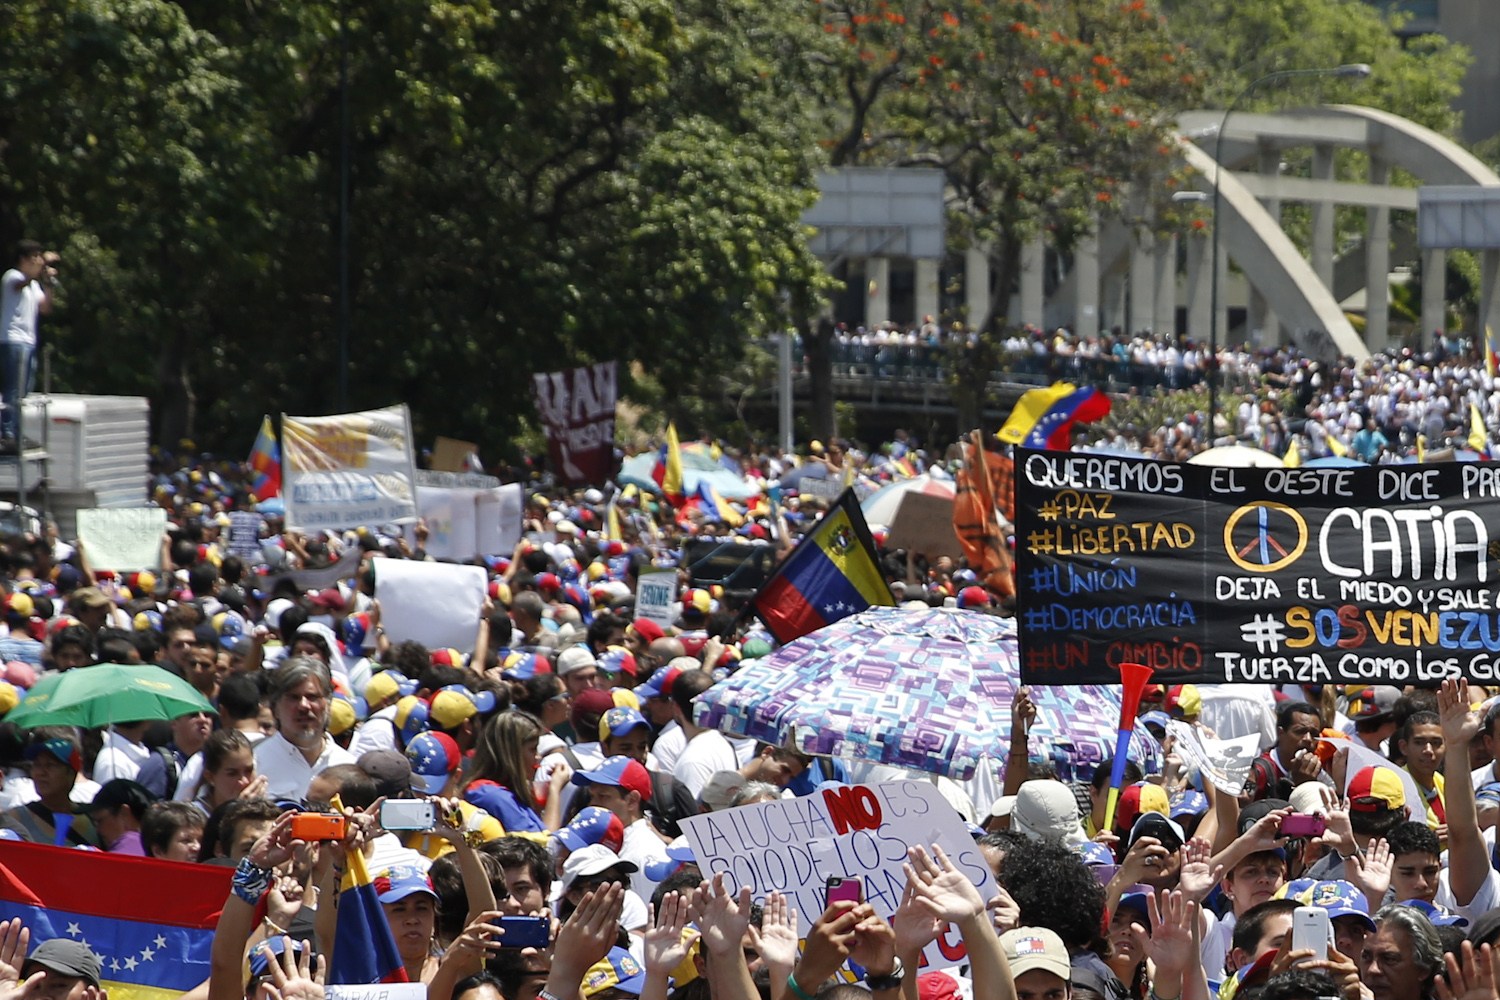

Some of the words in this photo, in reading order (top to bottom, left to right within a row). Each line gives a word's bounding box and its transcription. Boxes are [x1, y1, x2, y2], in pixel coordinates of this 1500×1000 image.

[1025, 454, 1184, 493] QUEREMOS
[1210, 467, 1246, 493] EL
[1264, 469, 1354, 496] OESTE
[1378, 470, 1440, 500] DICE
[1038, 489, 1116, 521] #PAZ
[1216, 575, 1281, 600] DEJA
[1297, 577, 1325, 599] EL
[1339, 580, 1412, 607] MIEDO
[1417, 589, 1434, 613] Y
[1437, 588, 1491, 610] SALE
[1026, 640, 1089, 672] #UN
[1215, 652, 1331, 682] FUERZA
[1338, 653, 1410, 680] COMO
[1416, 650, 1462, 680] LOS
[689, 817, 735, 858] LA
[729, 799, 833, 851] LUCHA
[822, 785, 882, 836] NO
[878, 782, 930, 818] ES
[710, 848, 787, 899] SOLO
[787, 838, 836, 886] DE
[832, 823, 909, 877] LOS
